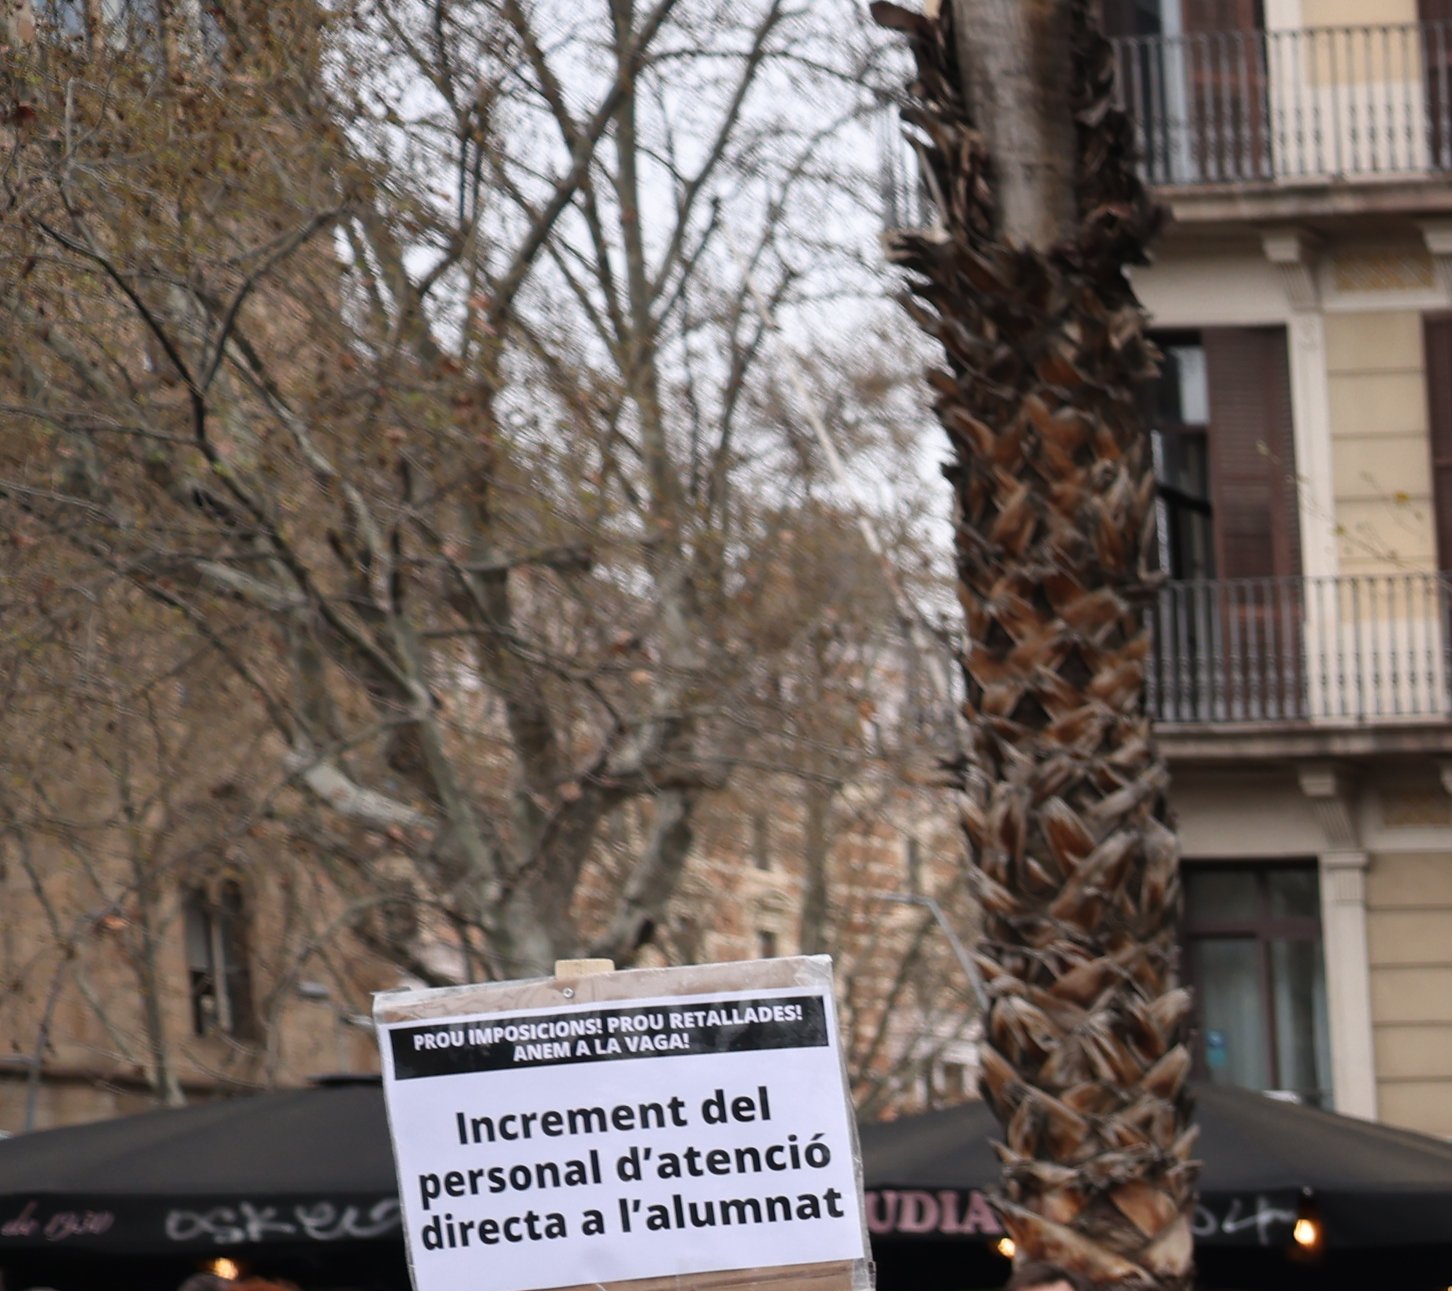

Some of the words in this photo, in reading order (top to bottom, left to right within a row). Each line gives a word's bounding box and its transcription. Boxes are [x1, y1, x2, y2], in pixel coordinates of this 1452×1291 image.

[413, 1029, 467, 1051] PROU
[468, 1018, 604, 1046] IMPOSICIONS!
[607, 1013, 665, 1033] PROU
[670, 1005, 802, 1029] RETALLADES!
[513, 1041, 571, 1062] ANEM
[575, 1040, 591, 1057] A
[595, 1038, 622, 1056] LA
[626, 1033, 690, 1052] VAGA!
[456, 1096, 688, 1145] Increment
[701, 1085, 771, 1125] del
[418, 1150, 602, 1211] personal
[615, 1132, 831, 1182] d'atenció
[421, 1210, 568, 1251] directa
[581, 1209, 605, 1236] a
[618, 1187, 845, 1233] l'alumnat
